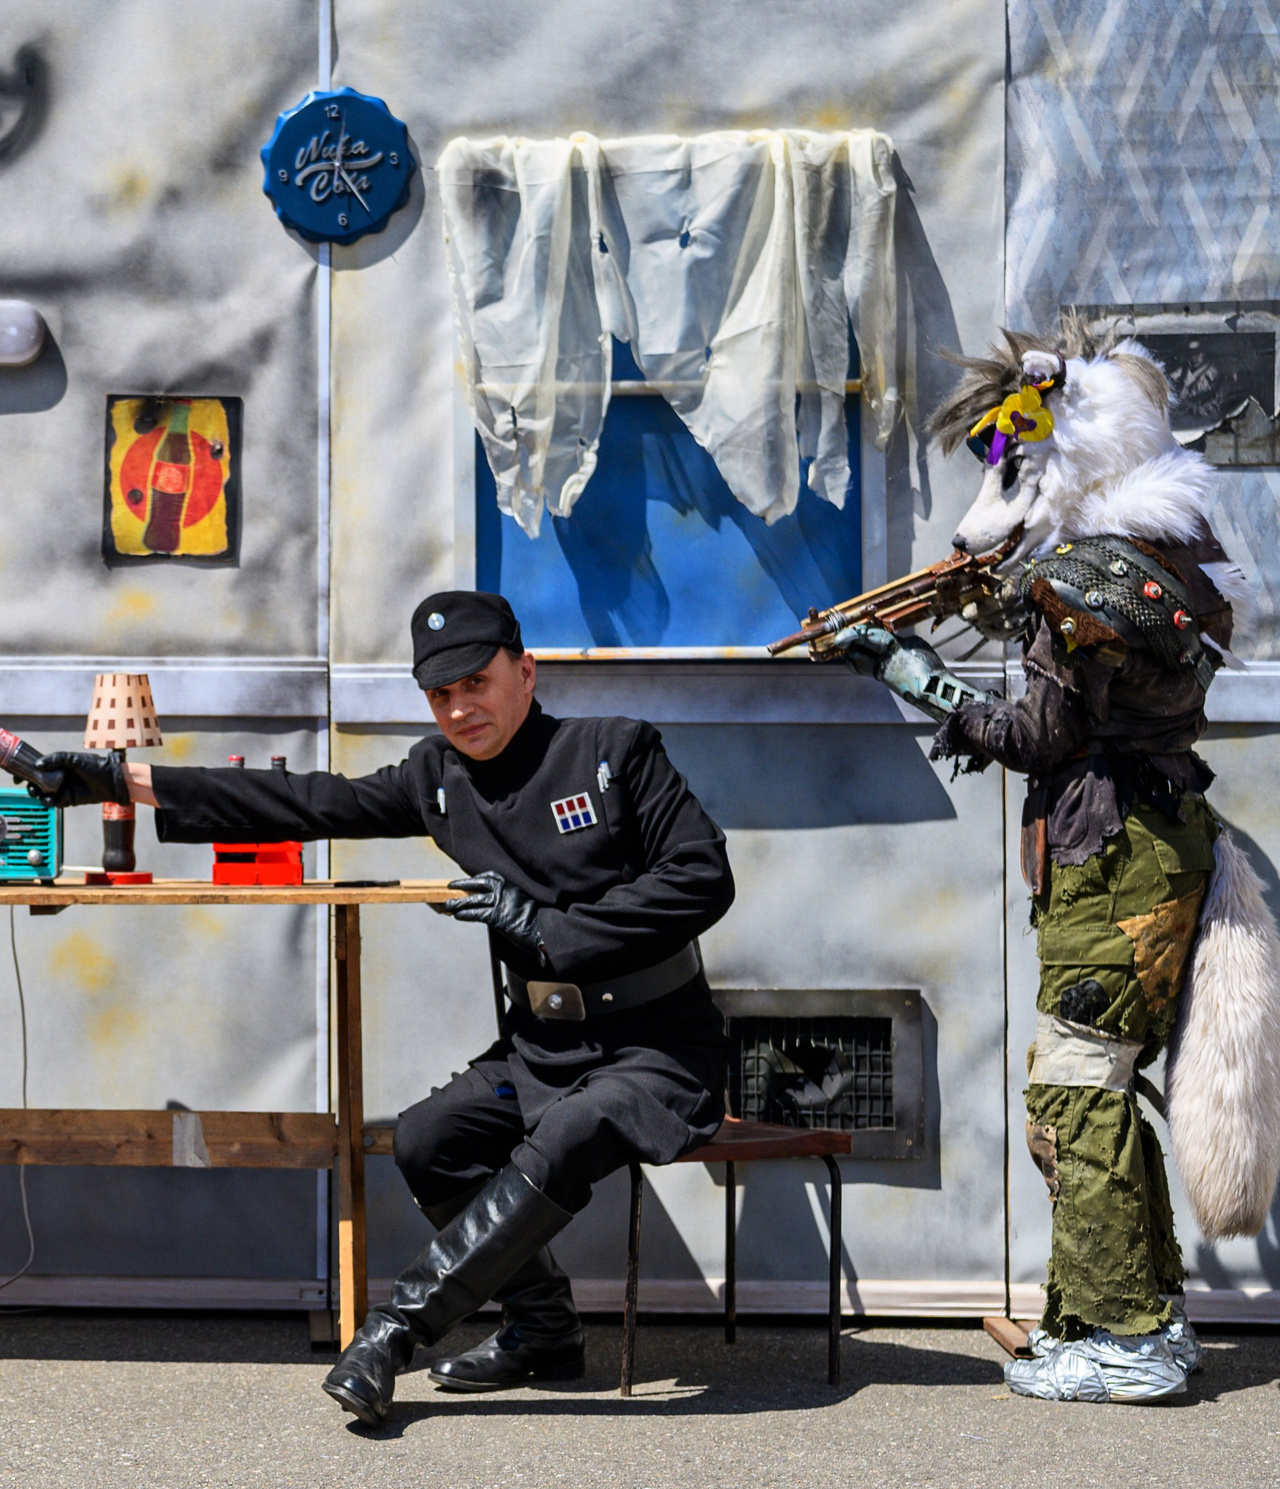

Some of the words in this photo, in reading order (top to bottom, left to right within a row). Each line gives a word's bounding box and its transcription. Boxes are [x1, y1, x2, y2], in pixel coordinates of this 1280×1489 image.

[324, 104, 340, 118] 12
[295, 130, 370, 170] Nuka
[389, 152, 400, 165] 3
[278, 169, 288, 182] 9
[338, 213, 348, 226] 6
